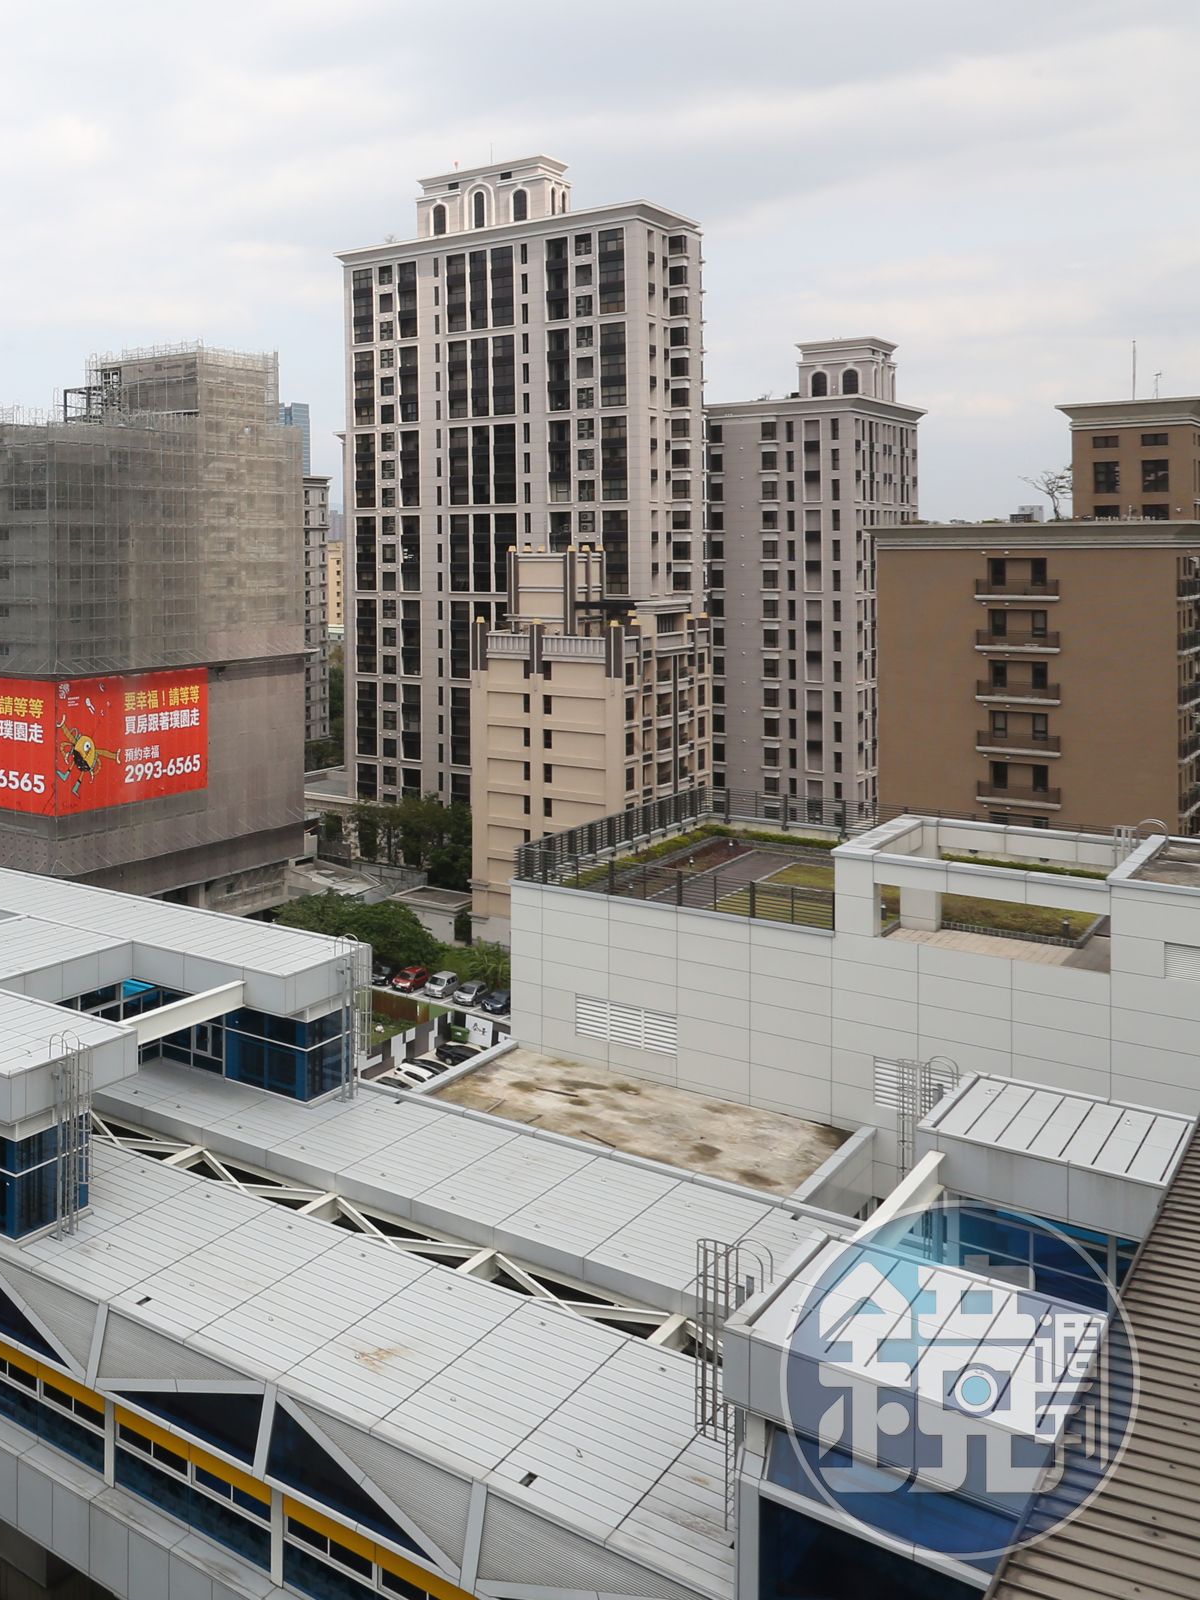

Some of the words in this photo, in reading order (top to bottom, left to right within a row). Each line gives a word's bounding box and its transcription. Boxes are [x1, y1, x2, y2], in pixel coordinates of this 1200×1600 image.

[124, 707, 200, 735] 買房跟著璞園走
[124, 744, 160, 763] 預約幸福
[124, 754, 201, 784] 2993-6565
